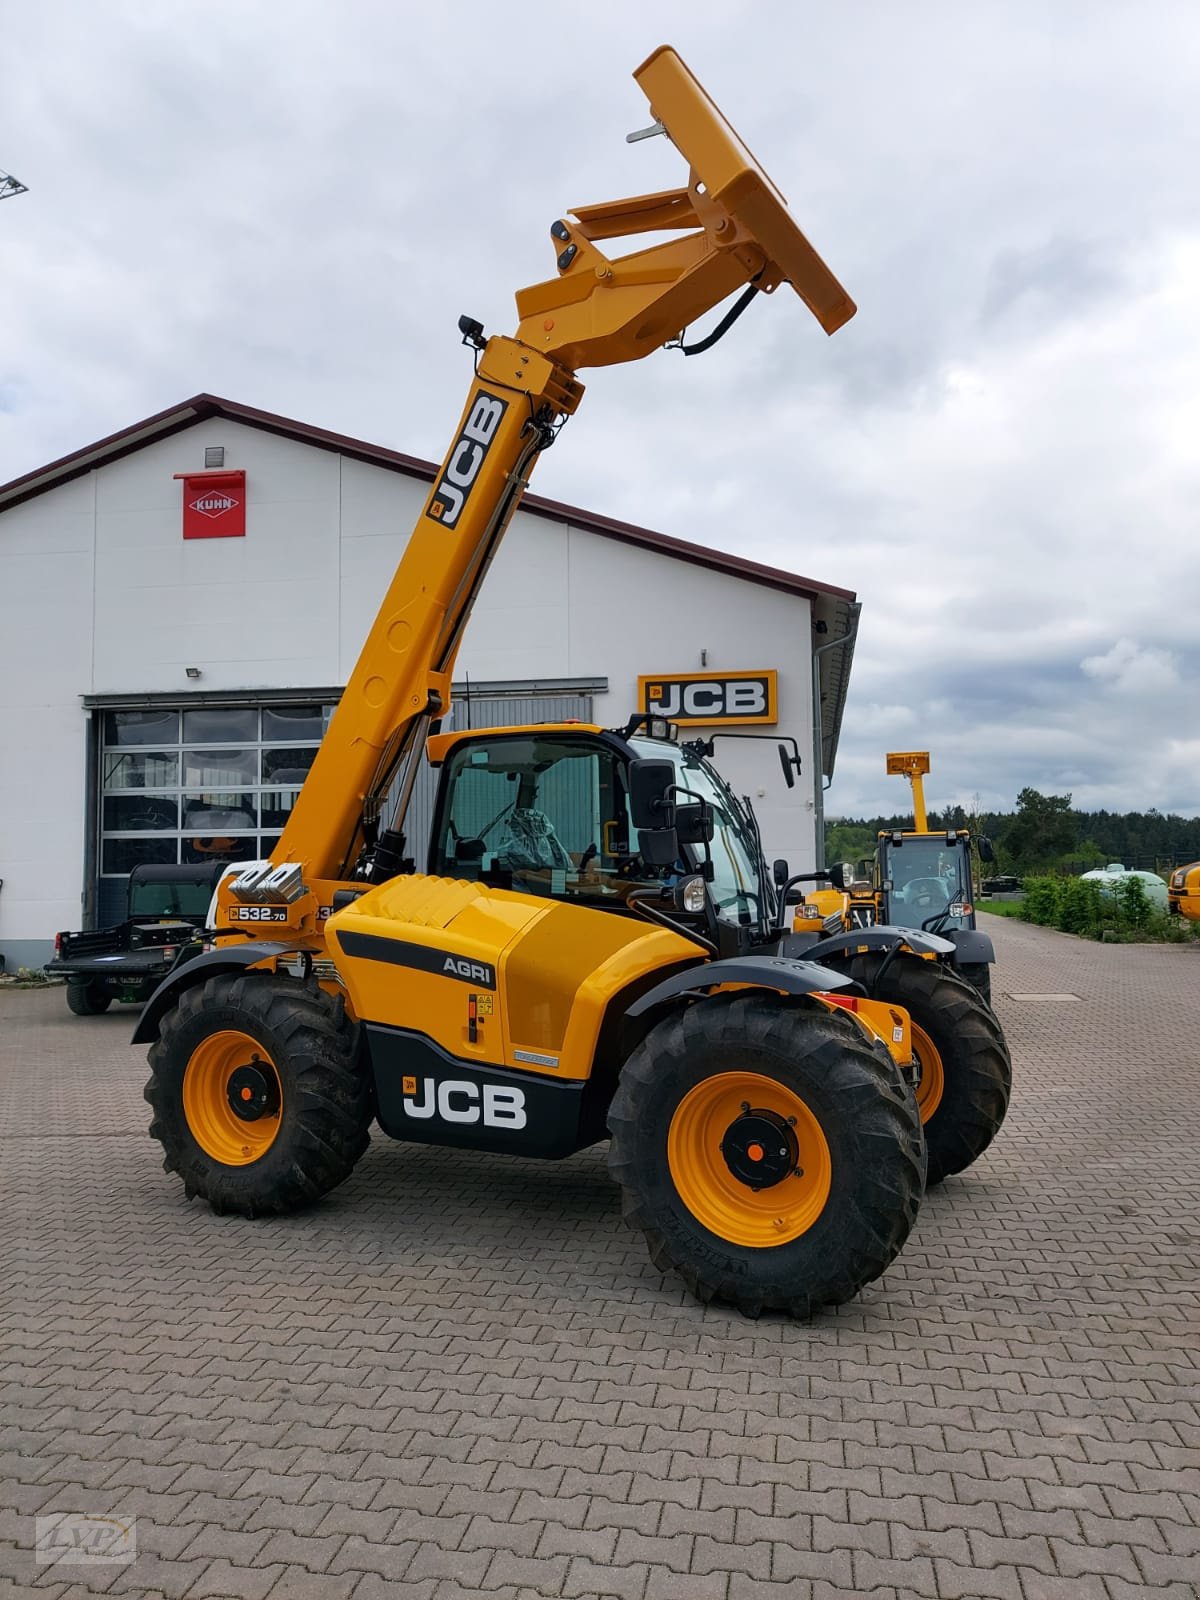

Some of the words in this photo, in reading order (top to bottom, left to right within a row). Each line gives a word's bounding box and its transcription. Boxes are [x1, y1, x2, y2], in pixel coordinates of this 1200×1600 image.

[439, 396, 503, 523] JCB
[196, 499, 231, 510] KUHN
[649, 681, 766, 716] JCB
[239, 907, 286, 921] 532-70
[443, 957, 490, 983] AGRI
[403, 1077, 527, 1130] JCB
